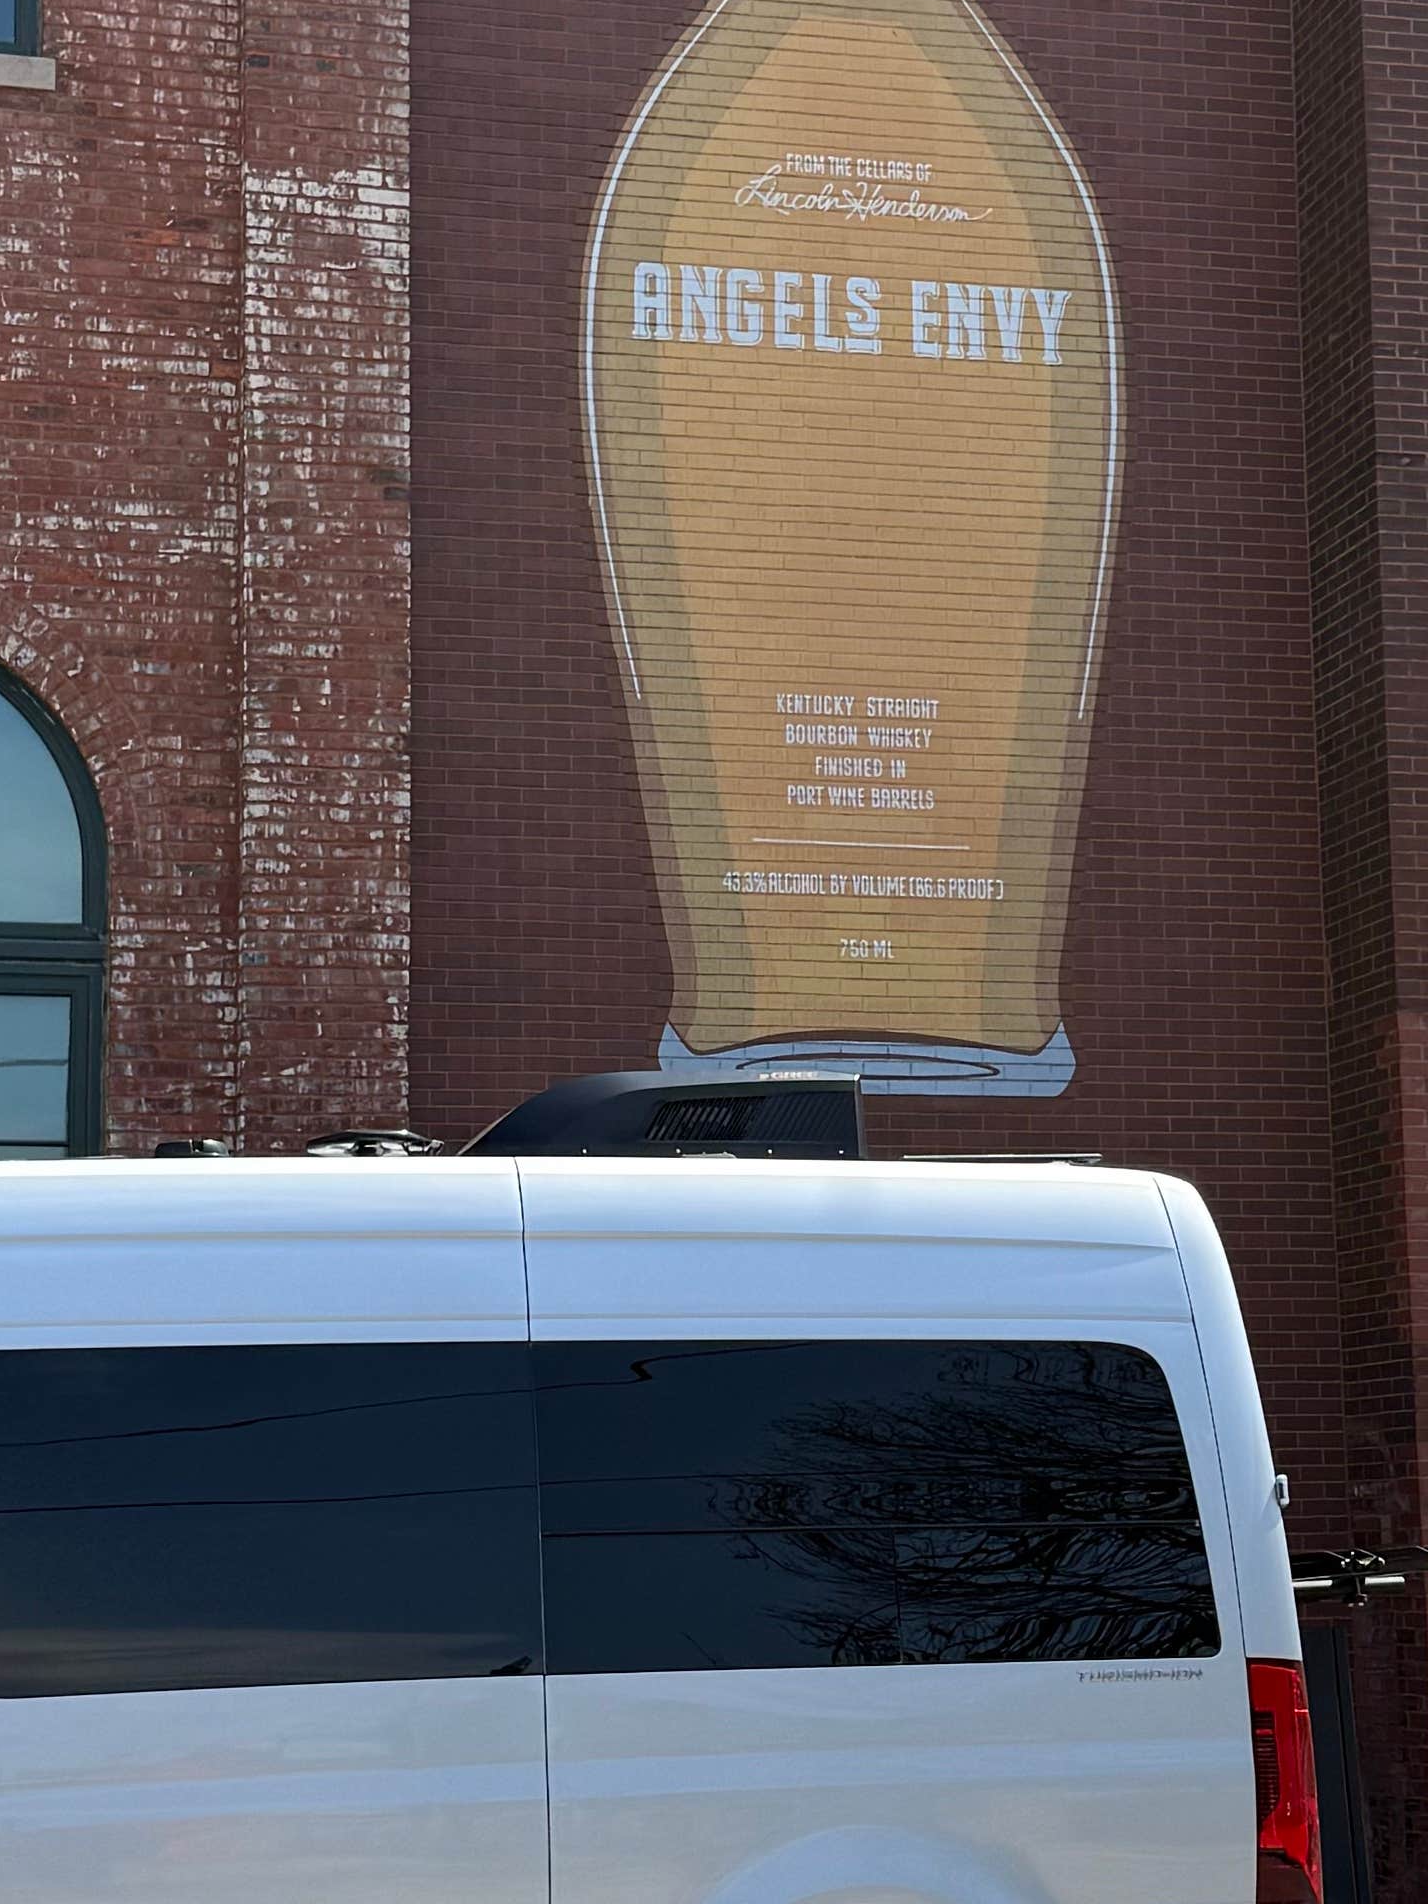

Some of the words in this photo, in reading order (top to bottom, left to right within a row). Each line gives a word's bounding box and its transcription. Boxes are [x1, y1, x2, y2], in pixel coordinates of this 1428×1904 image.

[786, 153, 825, 174] FROM
[828, 156, 852, 177] THE
[856, 158, 913, 181] CELLARS
[915, 162, 933, 182] OF
[735, 164, 840, 215] Lincoln
[911, 280, 1070, 366] ENVY
[776, 693, 855, 716] KENTUCKY
[867, 696, 940, 719] STRAIGHT
[785, 723, 858, 745] BOURBON
[868, 725, 932, 748] WHISKEY
[815, 755, 882, 777] FINISHED
[891, 758, 906, 778] IN
[787, 784, 824, 806] PORT
[828, 786, 865, 807] WINE
[871, 788, 934, 810] BARRELS
[768, 872, 826, 895] ALCOHOL
[830, 874, 847, 894] BY
[852, 875, 906, 897] VOLUME
[840, 938, 869, 958] 750
[873, 940, 895, 959] ML
